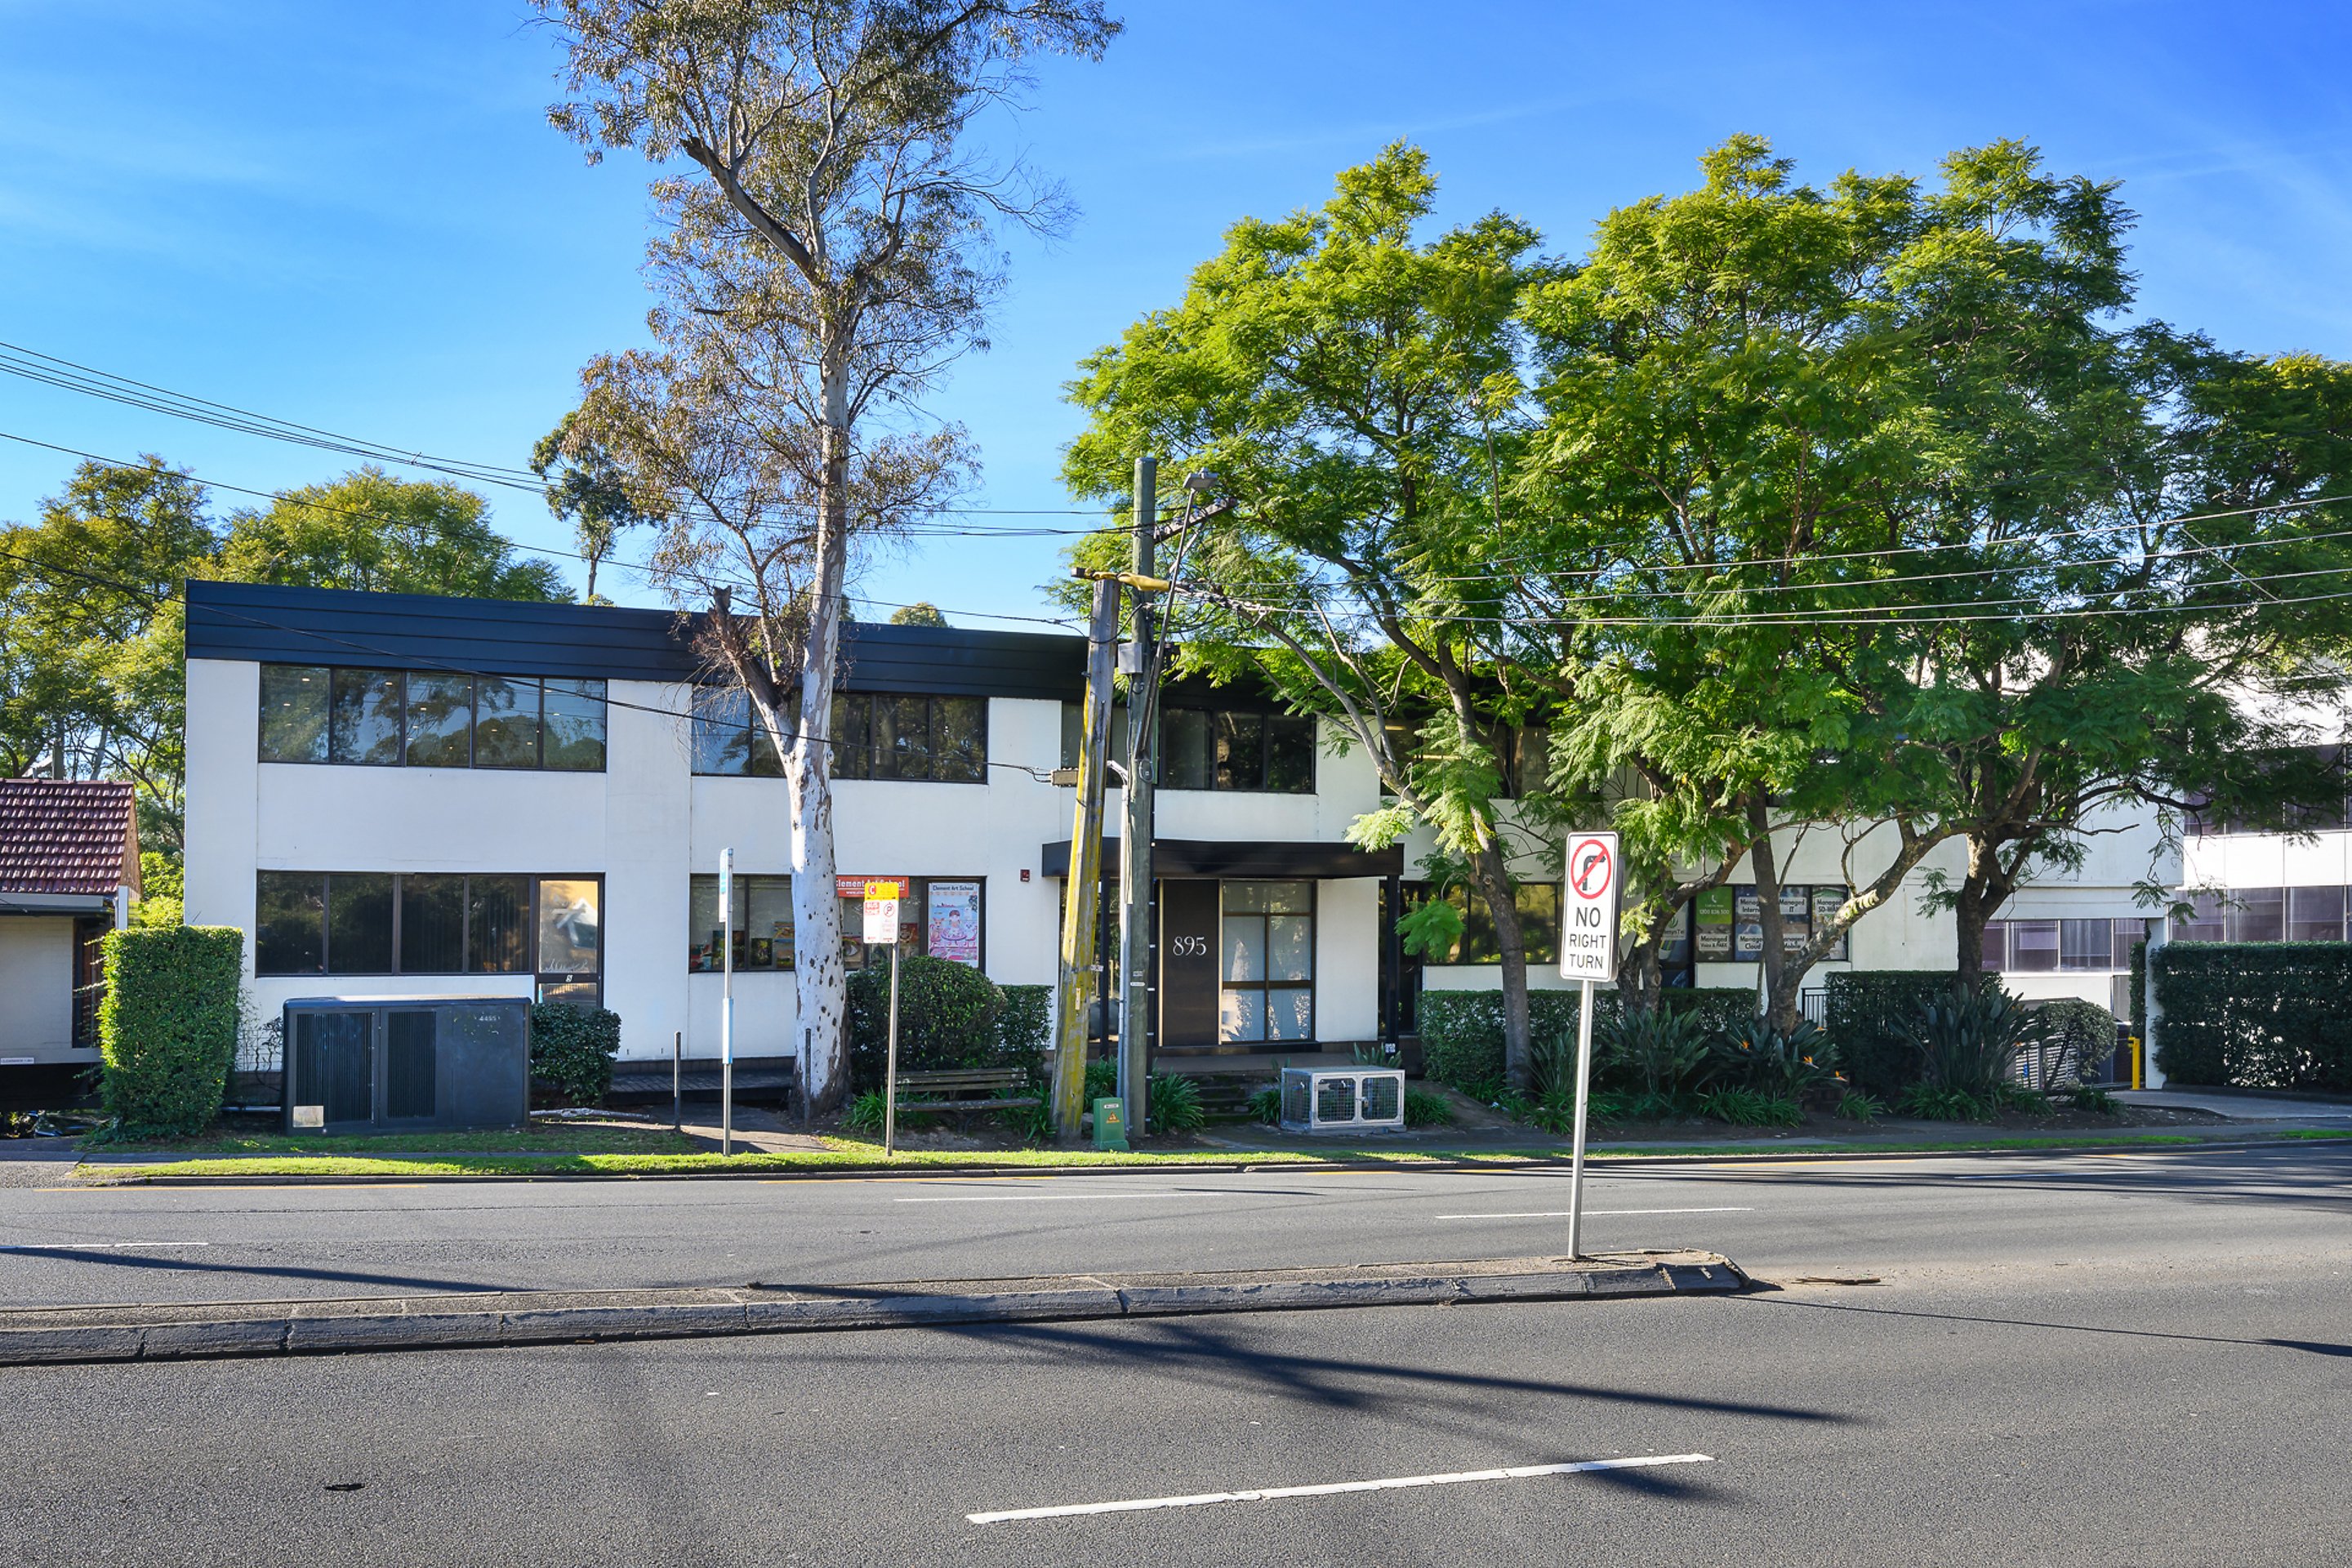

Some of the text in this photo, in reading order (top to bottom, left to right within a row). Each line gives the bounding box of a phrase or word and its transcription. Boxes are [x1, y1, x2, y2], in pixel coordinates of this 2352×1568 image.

[1780, 898, 1805, 906] Managed
[1817, 898, 1842, 906] Managed
[1576, 906, 1601, 928] NO
[1173, 936, 1206, 956] 895
[1570, 933, 1606, 948] RIGHT
[1700, 935, 1728, 943] Managed
[1570, 953, 1603, 969] TURN
